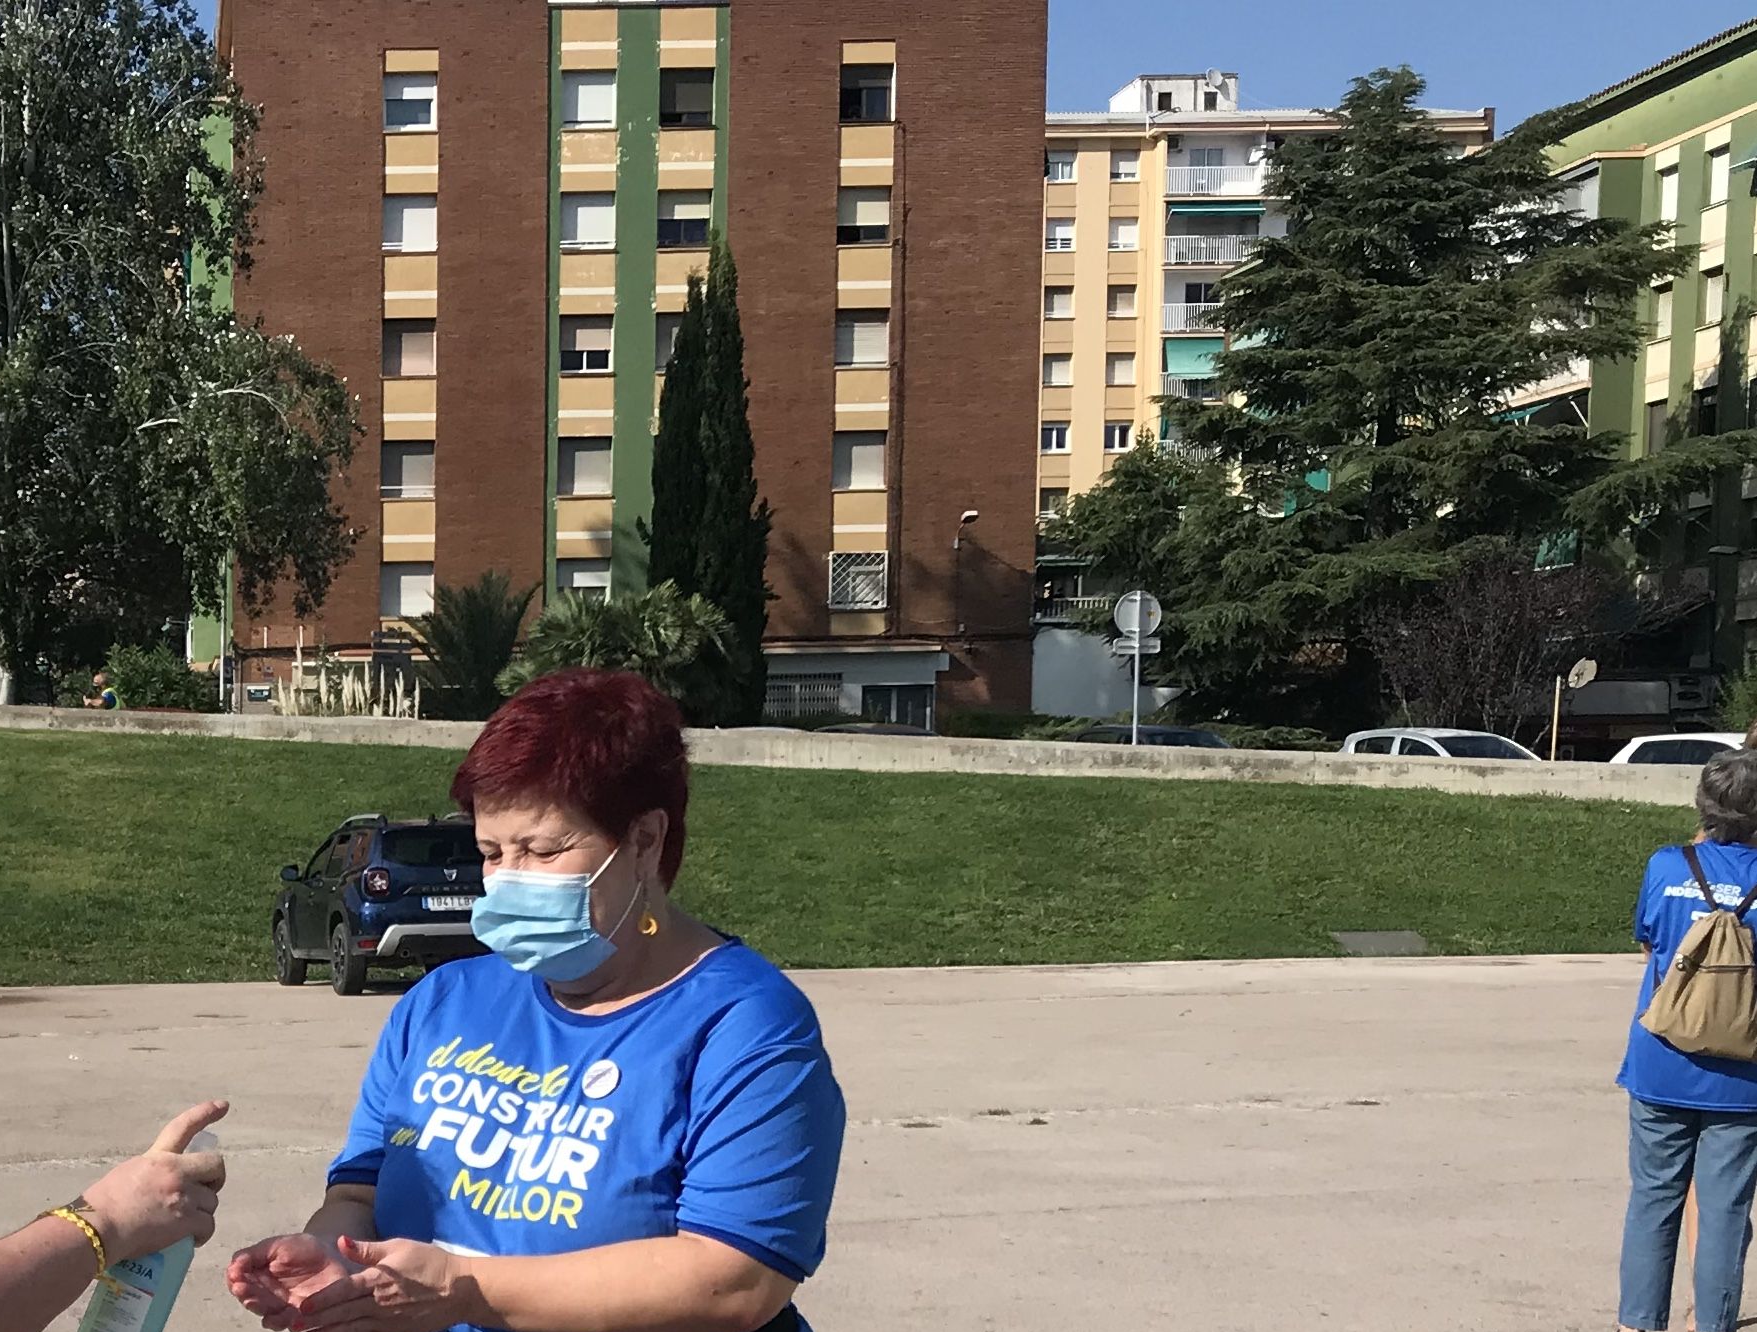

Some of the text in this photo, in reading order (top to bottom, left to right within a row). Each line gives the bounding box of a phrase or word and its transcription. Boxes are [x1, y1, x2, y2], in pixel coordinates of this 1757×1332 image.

[1716, 883, 1742, 897] SER
[412, 1071, 615, 1141] CONSTRUIR
[416, 1106, 600, 1190] FUTUR
[449, 1169, 584, 1229] MILLOR
